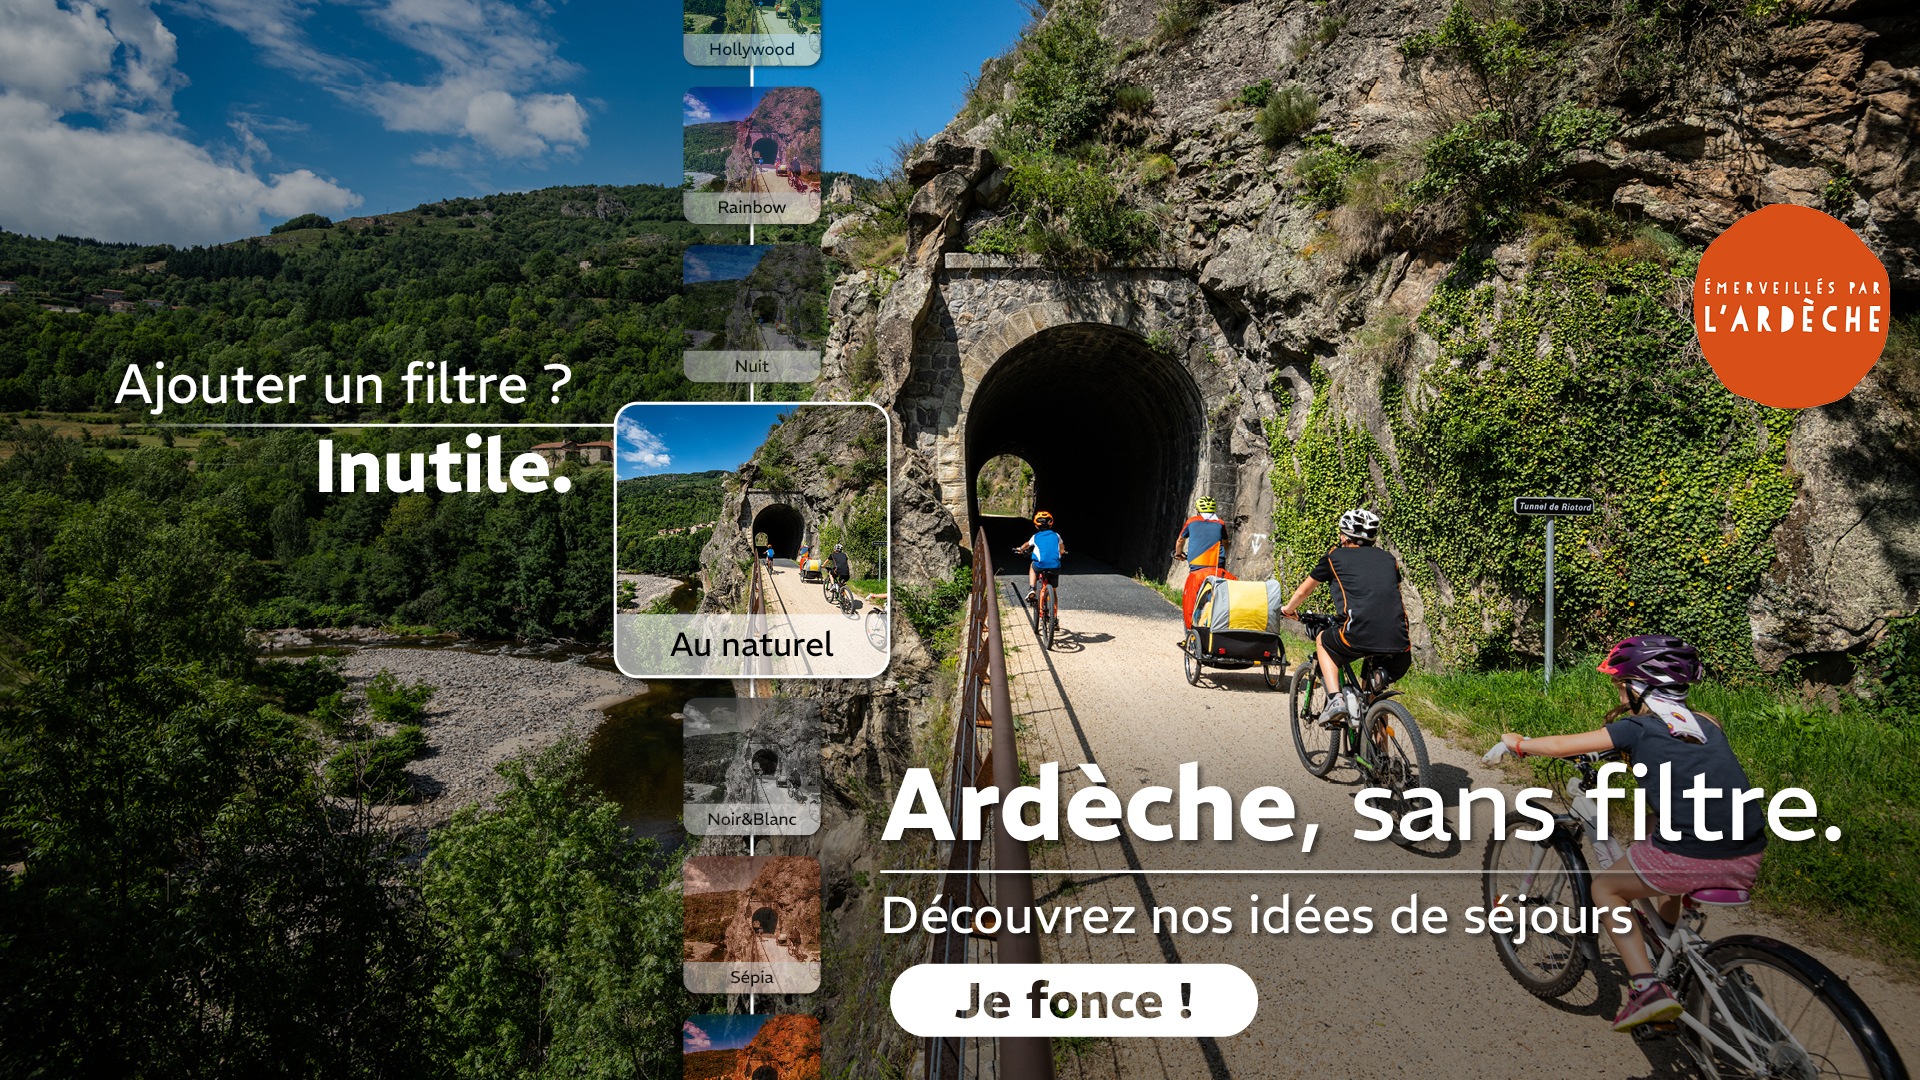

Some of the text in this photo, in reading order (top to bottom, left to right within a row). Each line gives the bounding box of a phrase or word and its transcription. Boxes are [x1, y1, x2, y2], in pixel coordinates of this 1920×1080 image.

[1519, 501, 1592, 512] Tunnel de Riotord
